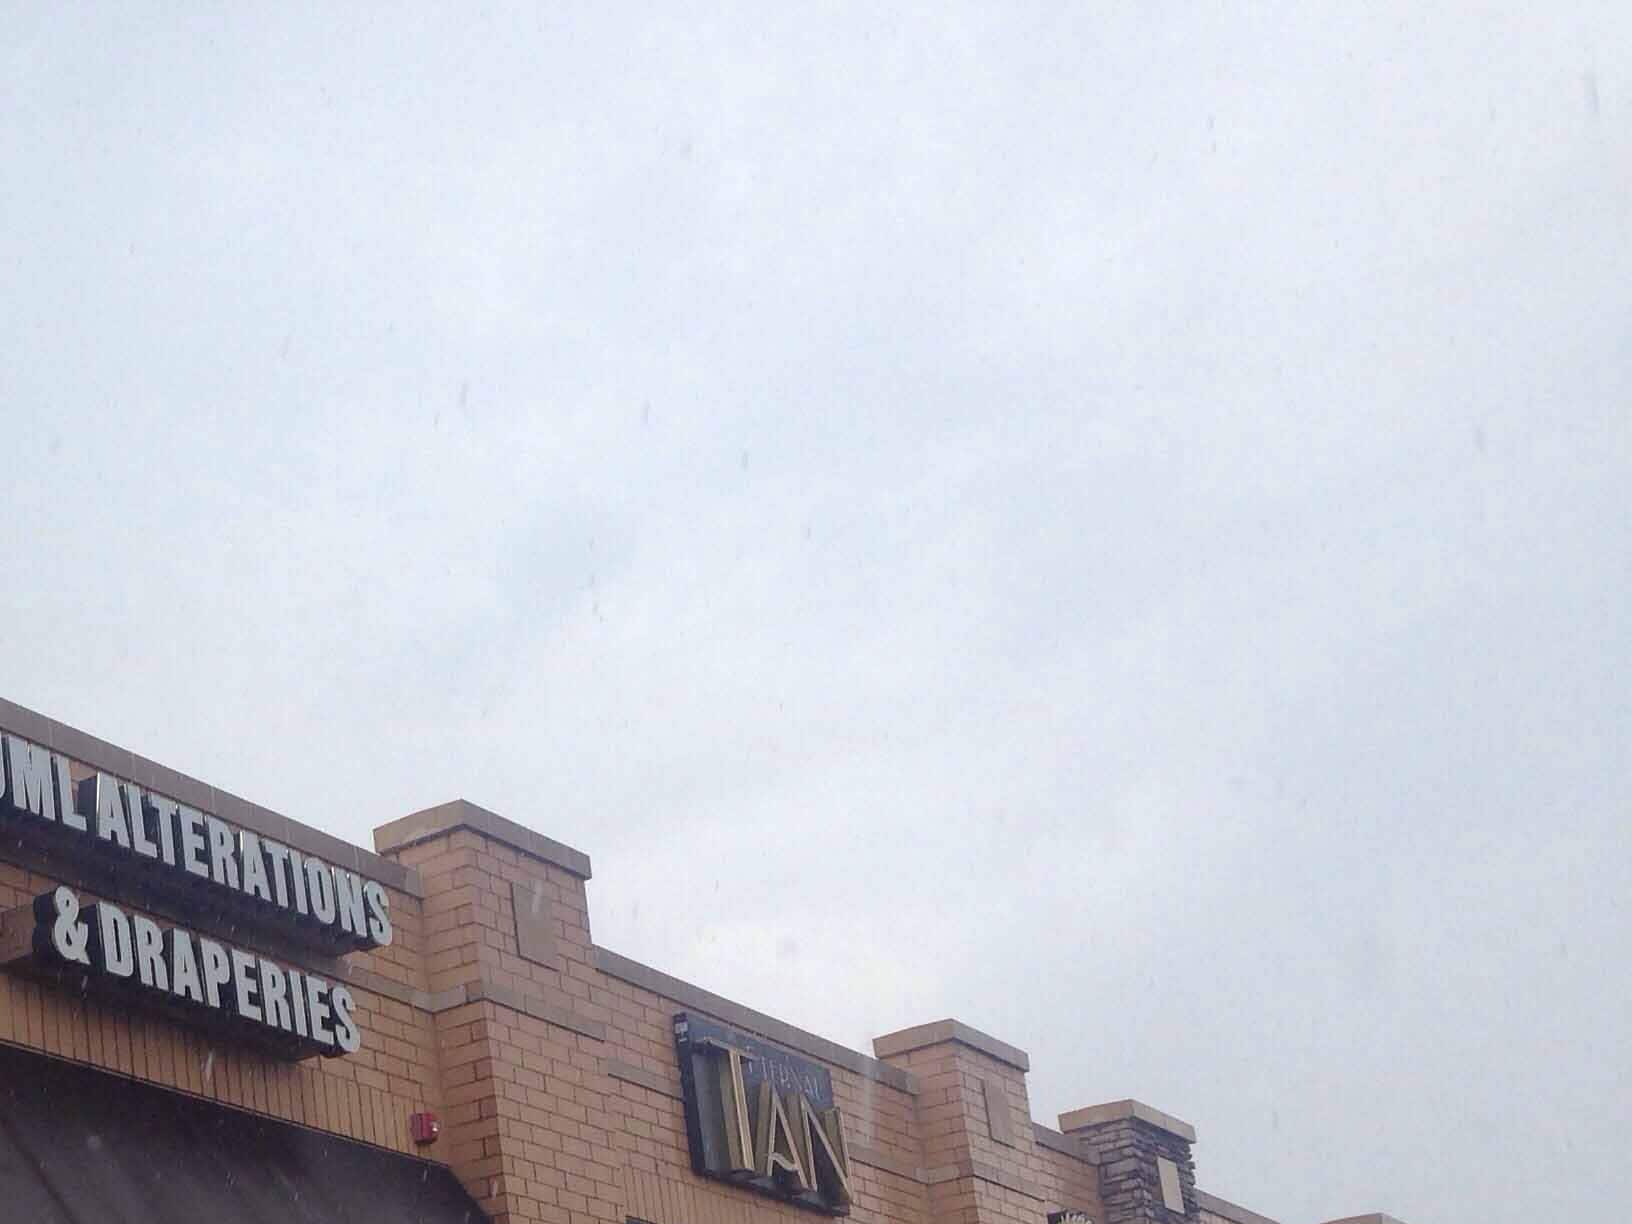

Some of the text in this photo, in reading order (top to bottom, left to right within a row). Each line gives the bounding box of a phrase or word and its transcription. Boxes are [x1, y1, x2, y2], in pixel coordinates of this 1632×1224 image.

[95, 771, 393, 947] ALTERATIONS
[52, 885, 361, 1054] & DRAPERIES
[696, 1037, 854, 1202] TAN
